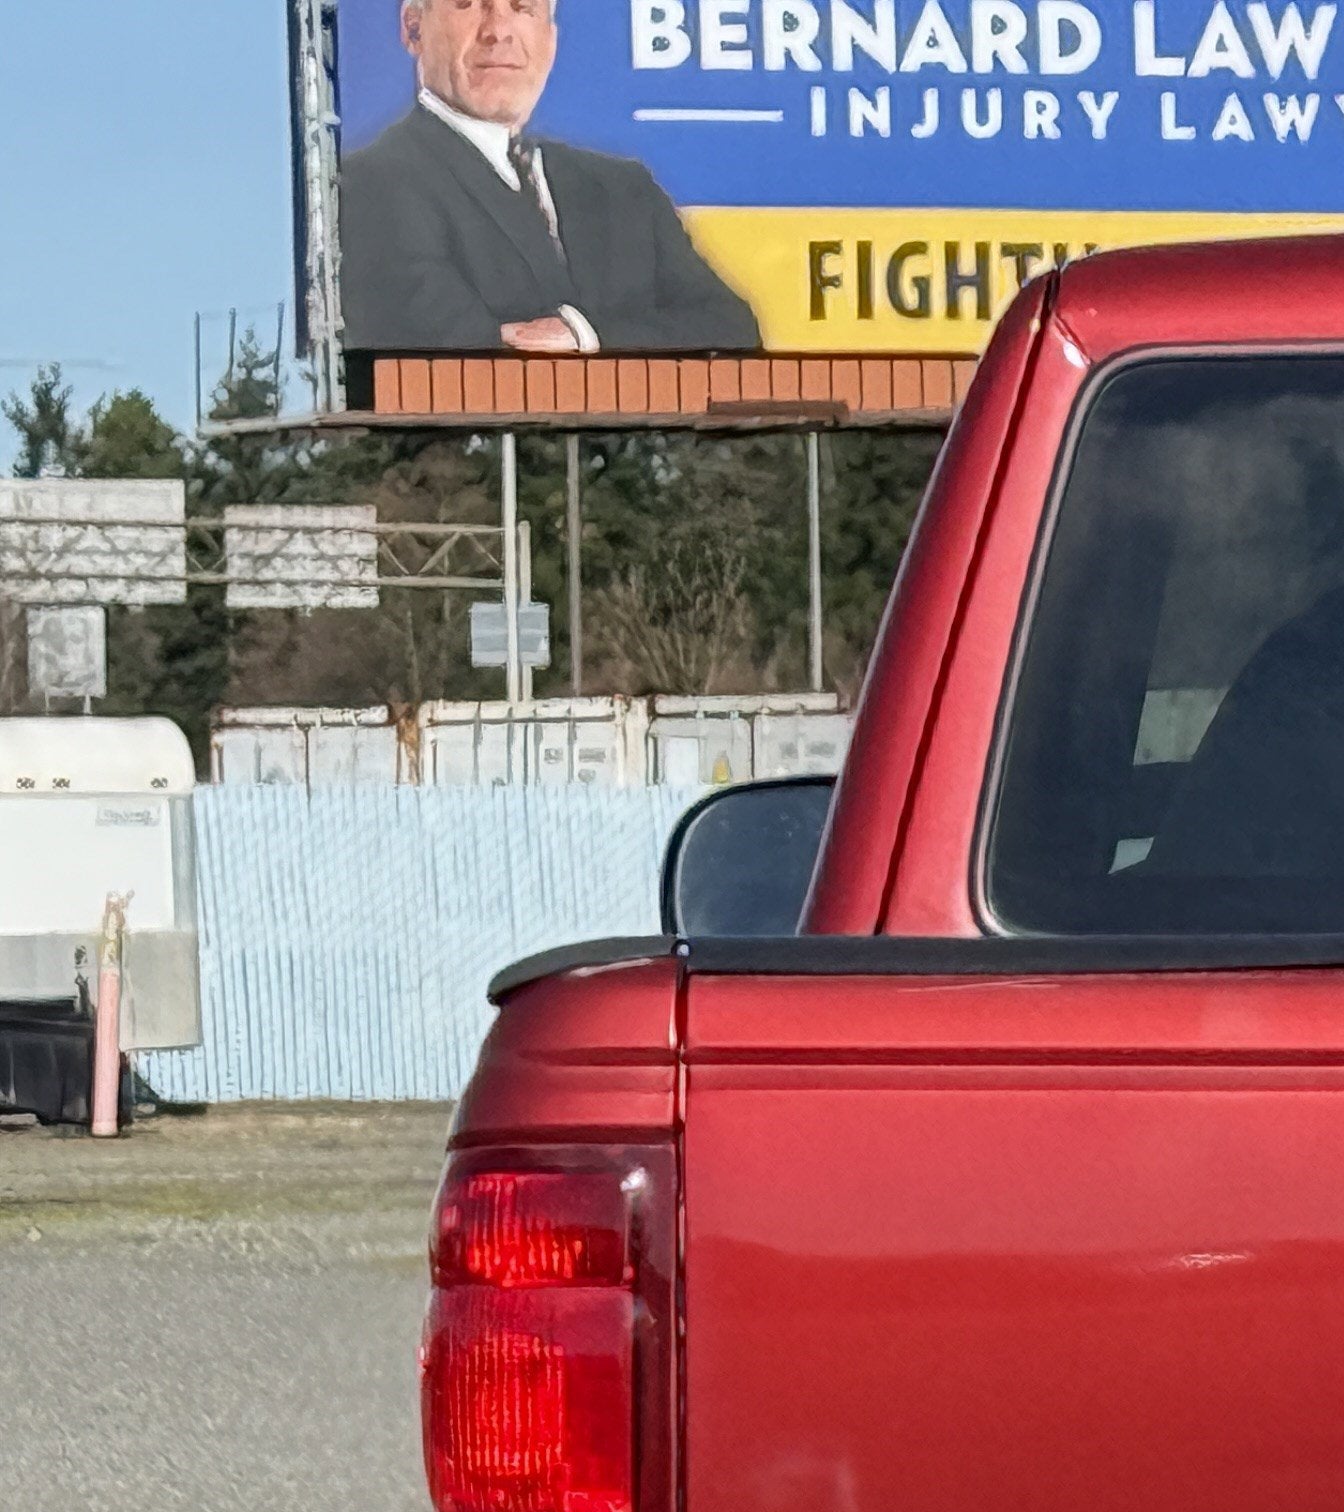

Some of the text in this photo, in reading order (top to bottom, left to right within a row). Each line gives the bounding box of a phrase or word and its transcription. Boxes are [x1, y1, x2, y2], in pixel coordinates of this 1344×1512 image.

[632, 0, 1102, 74] BERNARD
[1133, 0, 1337, 80] LAW
[810, 86, 1120, 140] INJURY
